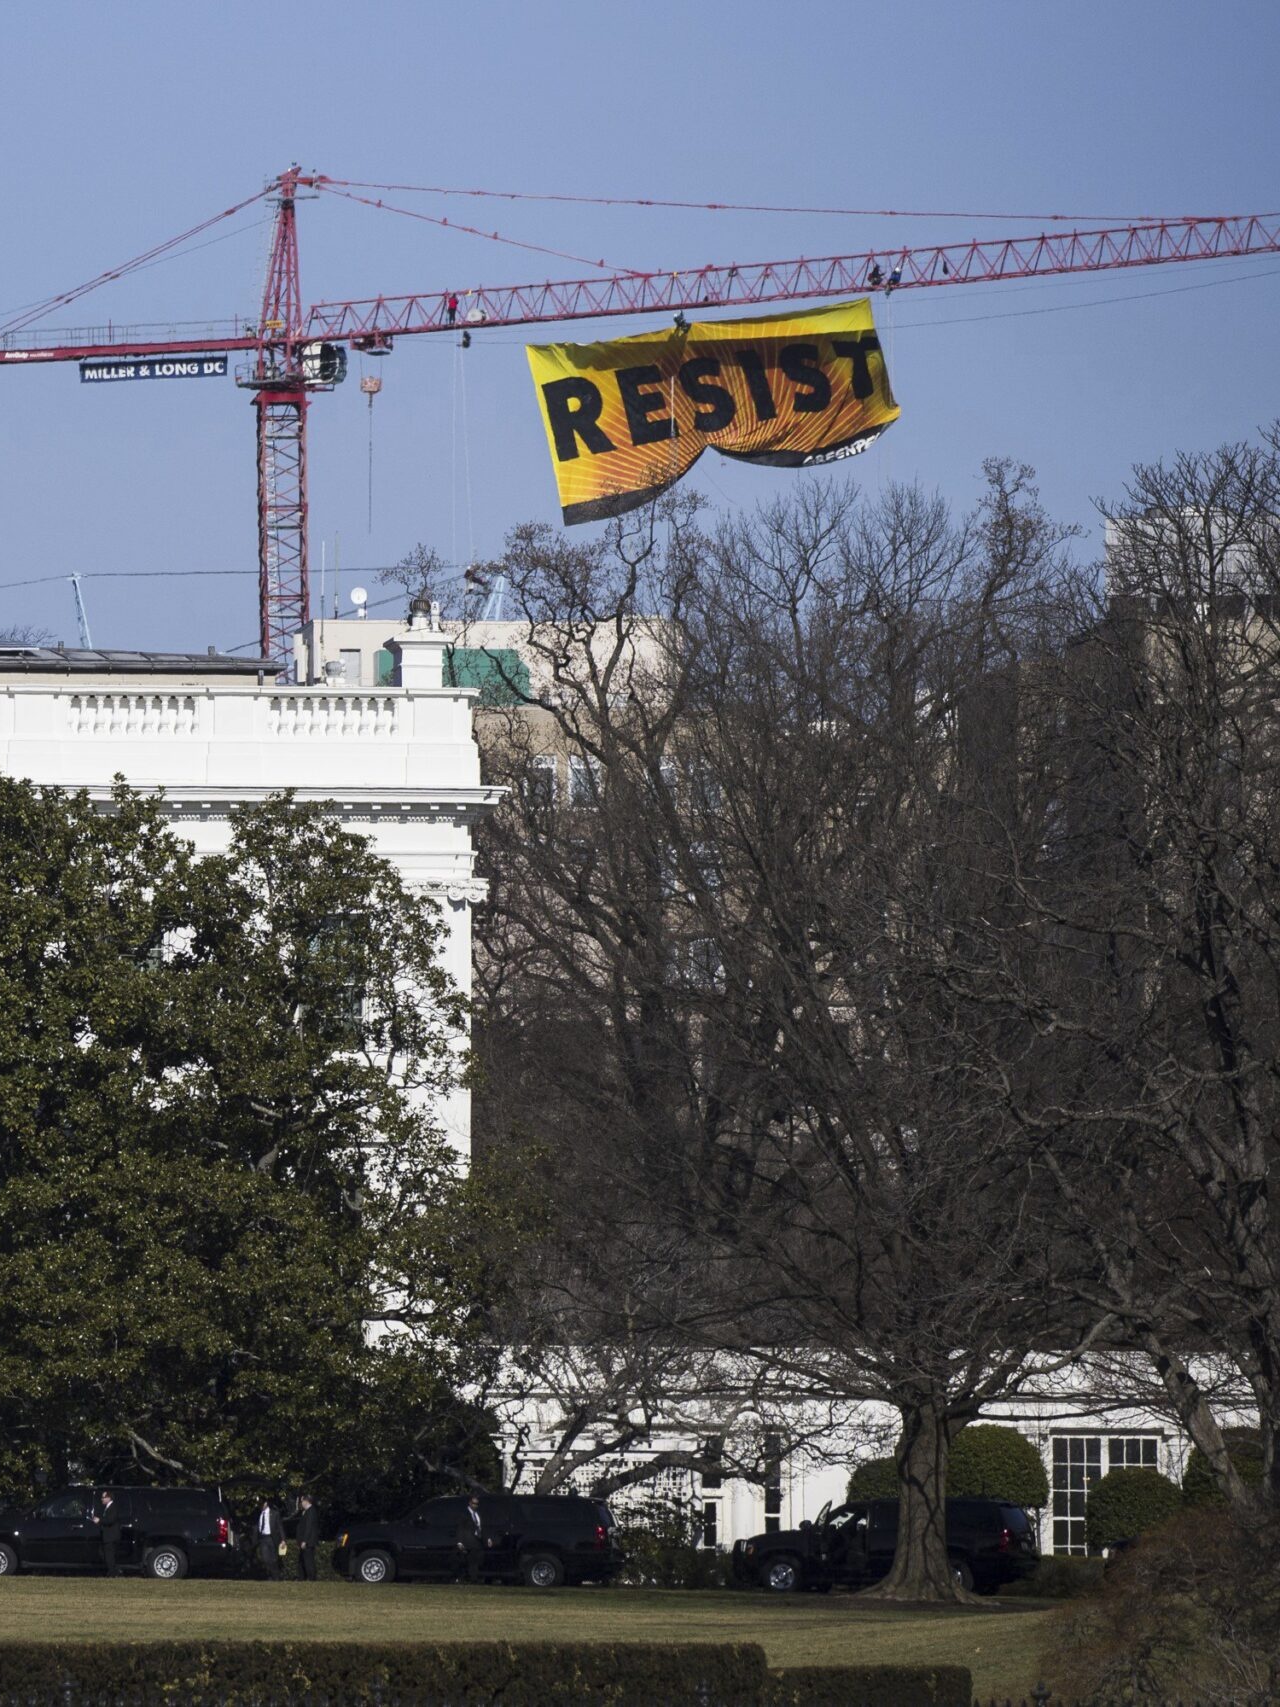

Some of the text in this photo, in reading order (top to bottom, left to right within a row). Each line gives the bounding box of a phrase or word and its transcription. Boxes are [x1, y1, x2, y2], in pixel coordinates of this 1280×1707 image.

[84, 362, 224, 380] MILLER & LONG DC
[541, 337, 881, 462] RESIST
